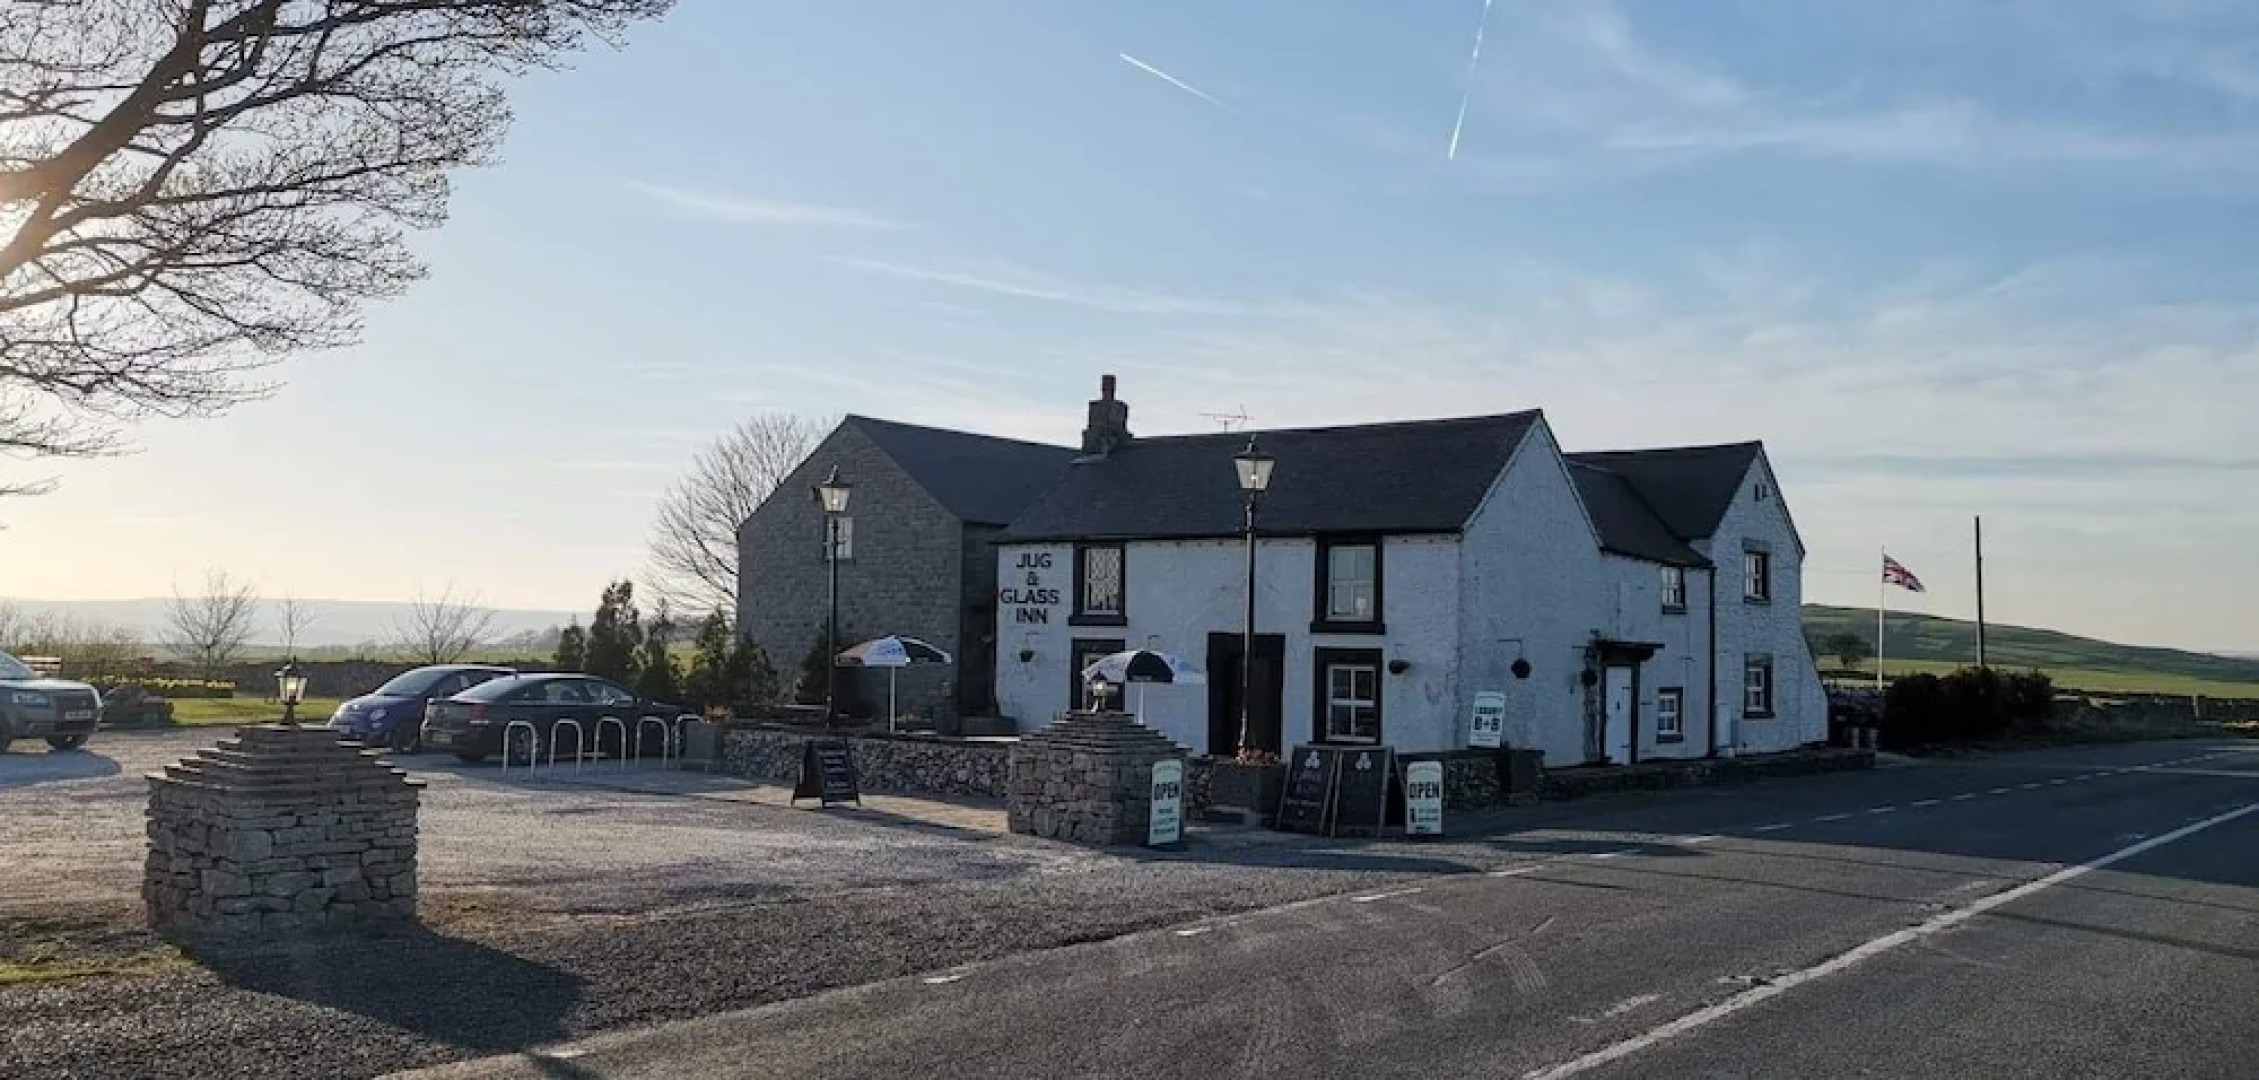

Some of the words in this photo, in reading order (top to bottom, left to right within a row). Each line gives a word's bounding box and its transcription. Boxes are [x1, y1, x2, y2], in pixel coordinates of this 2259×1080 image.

[1016, 553, 1052, 568] JUG
[1026, 571, 1039, 586] &
[1000, 589, 1060, 604] GLASS
[1016, 608, 1048, 624] INN
[1154, 781, 1180, 801] OPEN
[1409, 782, 1440, 799] OPEN
